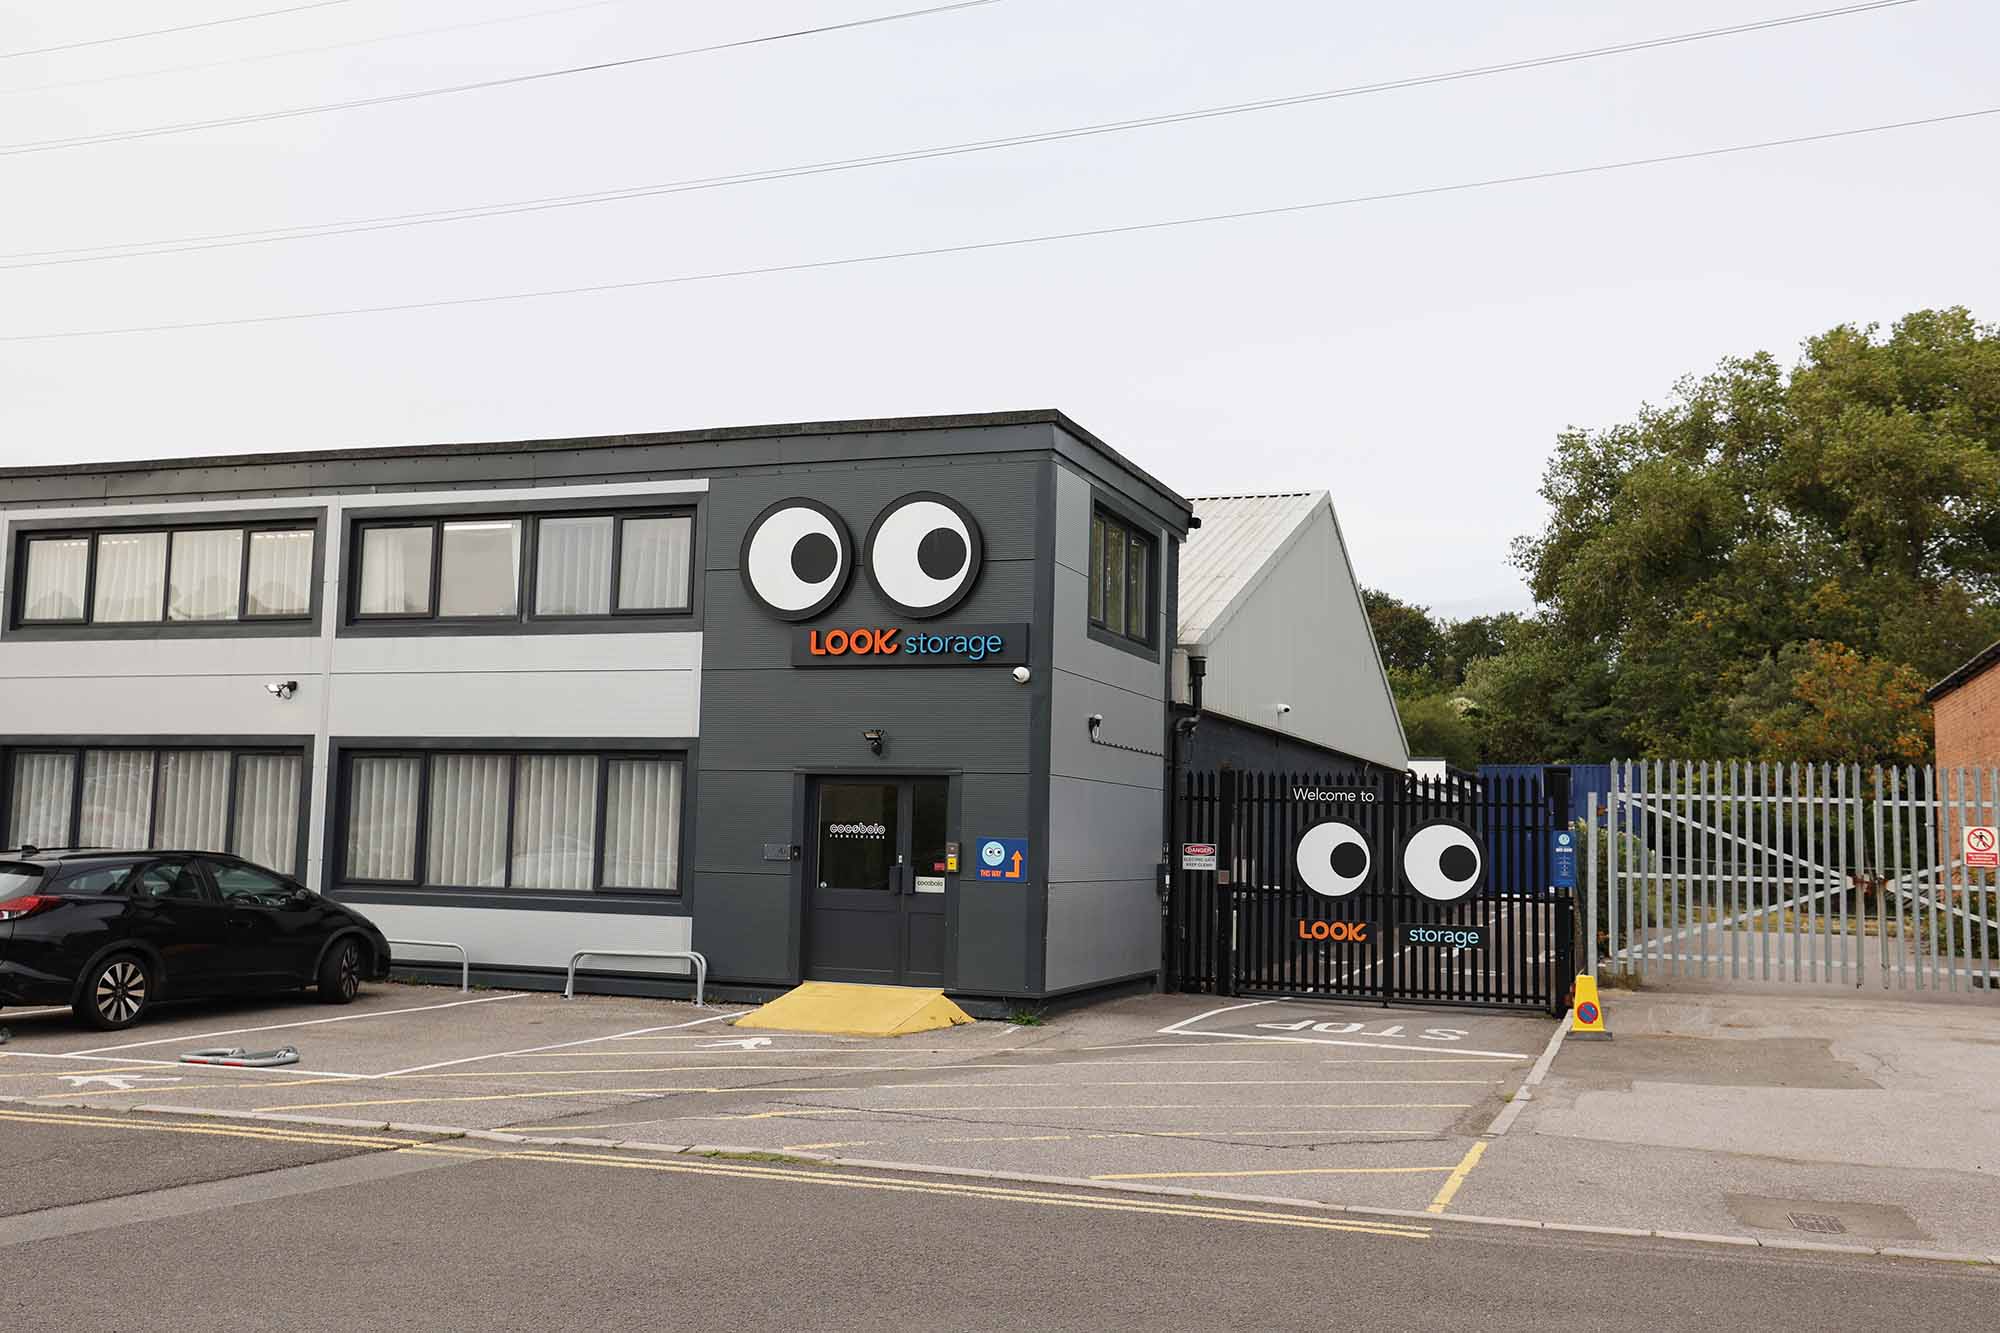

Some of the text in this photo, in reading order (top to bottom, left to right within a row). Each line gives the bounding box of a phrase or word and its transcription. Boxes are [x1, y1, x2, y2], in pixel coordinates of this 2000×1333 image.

[809, 628, 1002, 660] LOOK storage
[1293, 787, 1375, 802] Welcome to
[1299, 920, 1480, 948] LOOK storage
[1256, 1020, 1469, 1041] STOP
